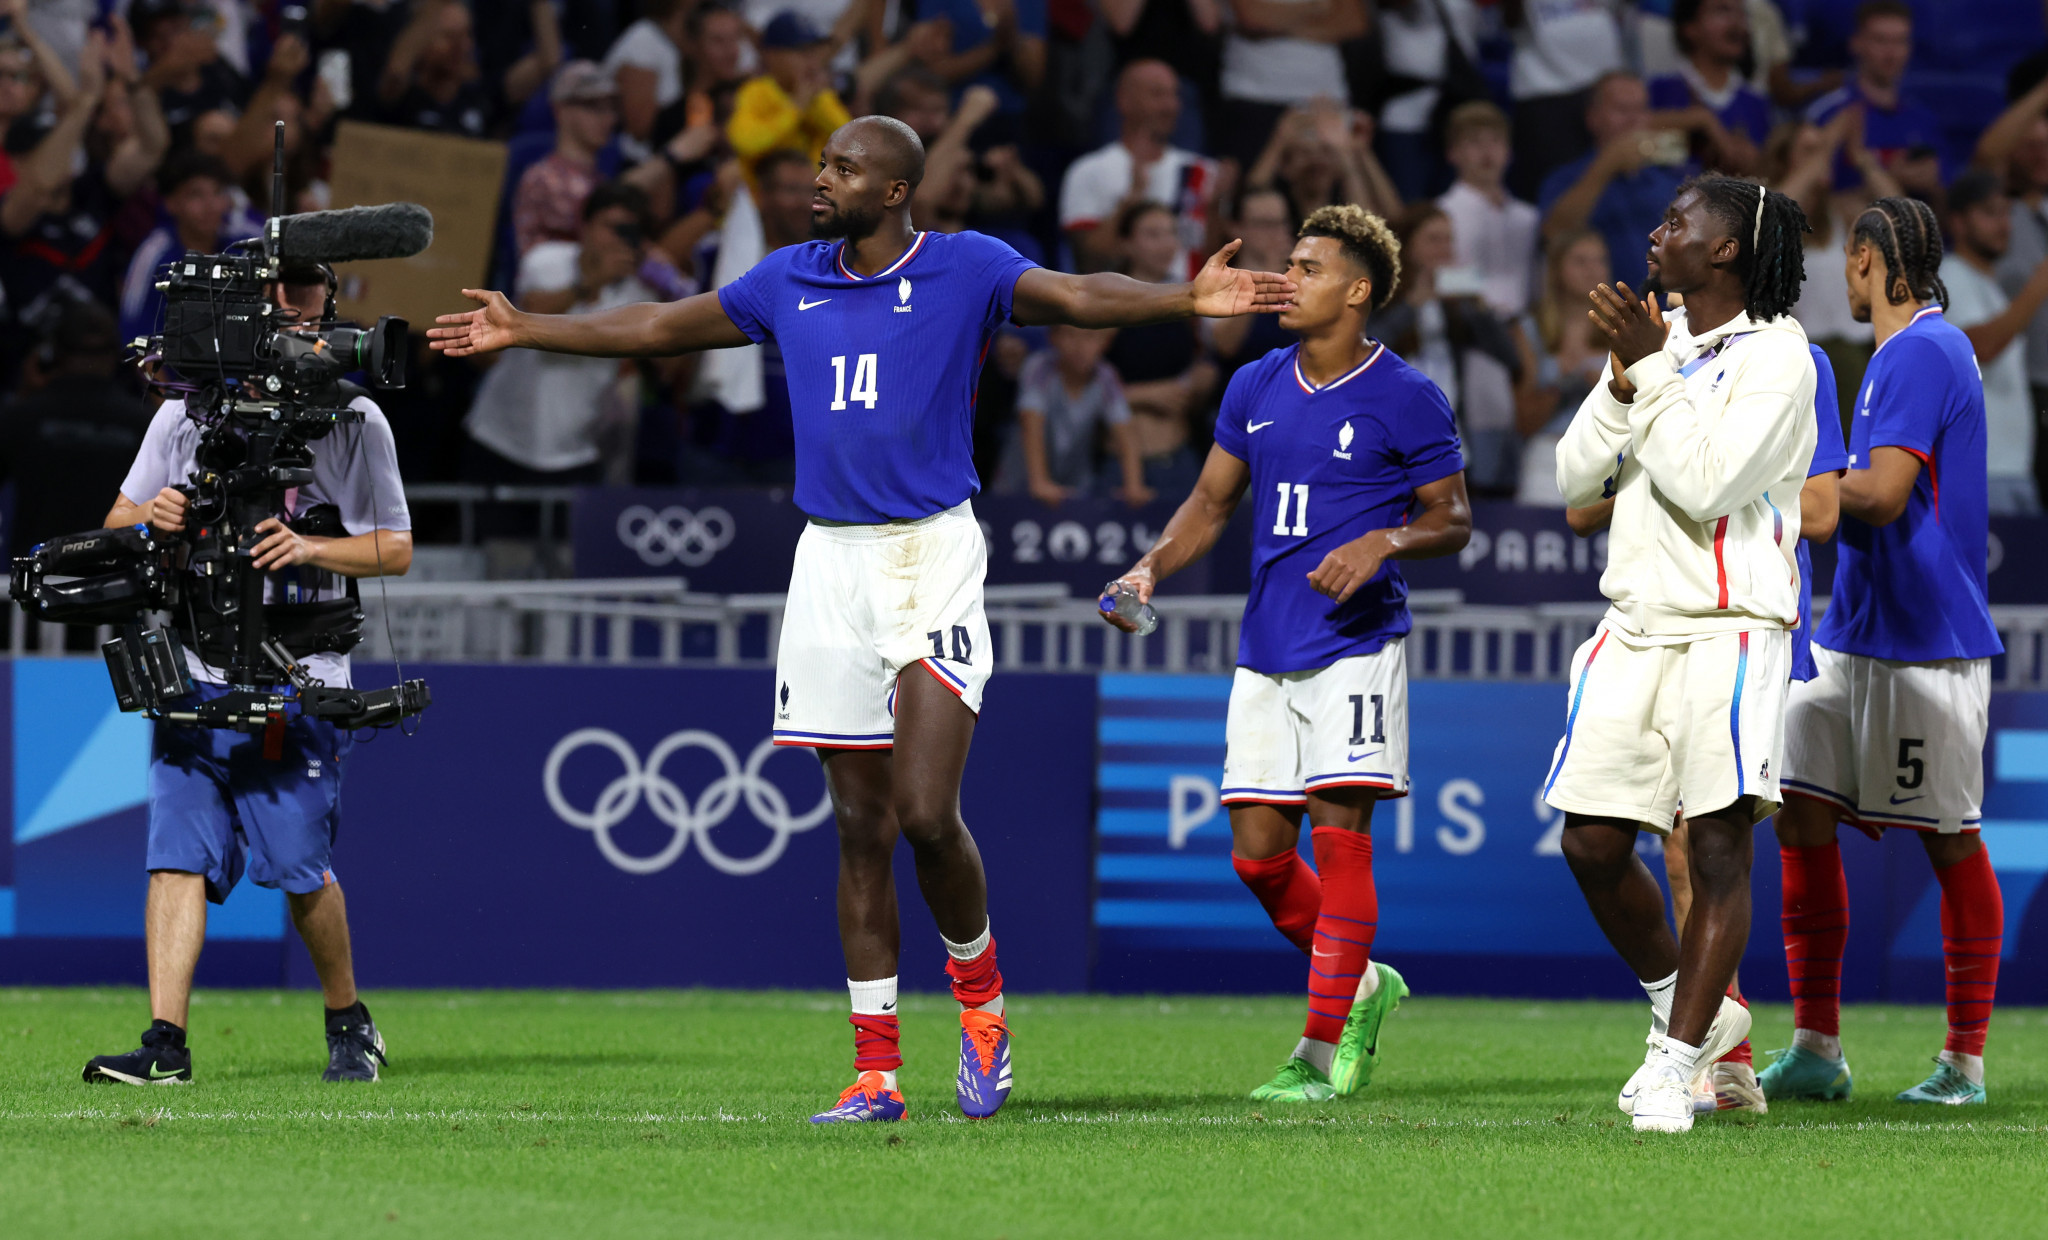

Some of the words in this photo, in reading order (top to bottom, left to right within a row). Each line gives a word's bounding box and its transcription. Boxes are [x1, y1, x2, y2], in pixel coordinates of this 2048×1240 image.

[893, 305, 912, 313] FRANCE
[830, 353, 878, 411] 14
[1333, 449, 1352, 461] FRANCE
[1273, 482, 1309, 537] 11
[61, 538, 97, 553] PRO
[1348, 694, 1386, 745] 11
[307, 768, 321, 778] OBS
[1896, 738, 1925, 790] 5
